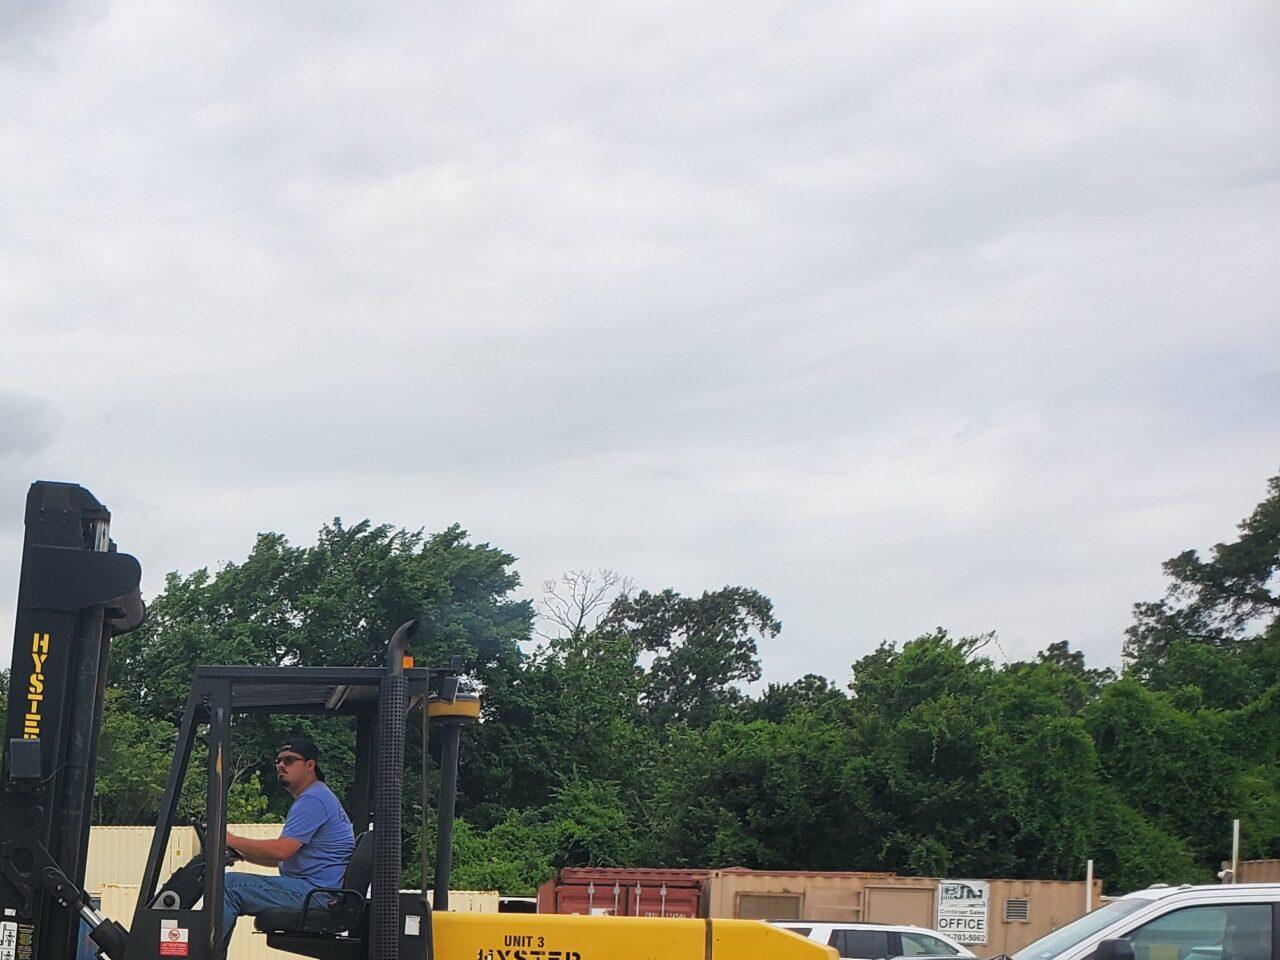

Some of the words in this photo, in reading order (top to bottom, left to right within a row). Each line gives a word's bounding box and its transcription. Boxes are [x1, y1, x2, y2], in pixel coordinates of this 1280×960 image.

[23, 632, 50, 739] HYSTE
[939, 918, 985, 930] OFFICE
[504, 935, 533, 948] UNIT
[537, 936, 545, 948] 3
